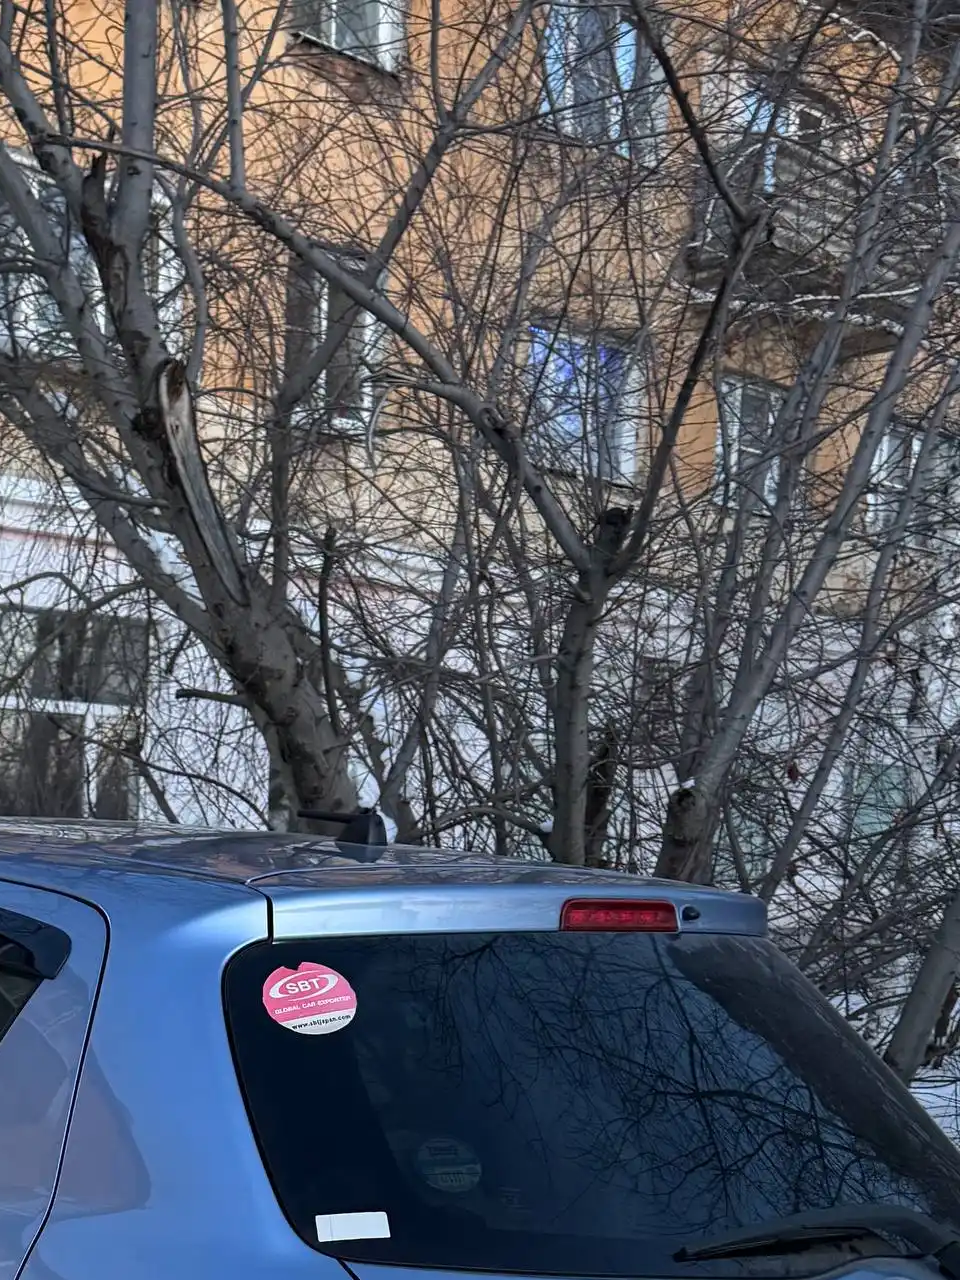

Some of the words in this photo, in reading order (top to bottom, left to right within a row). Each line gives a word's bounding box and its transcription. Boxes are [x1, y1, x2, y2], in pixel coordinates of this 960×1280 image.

[285, 978, 320, 994] SBT
[274, 1004, 301, 1015] GLOBAL
[302, 1001, 316, 1009] CAR
[317, 995, 352, 1006] EXPORTER
